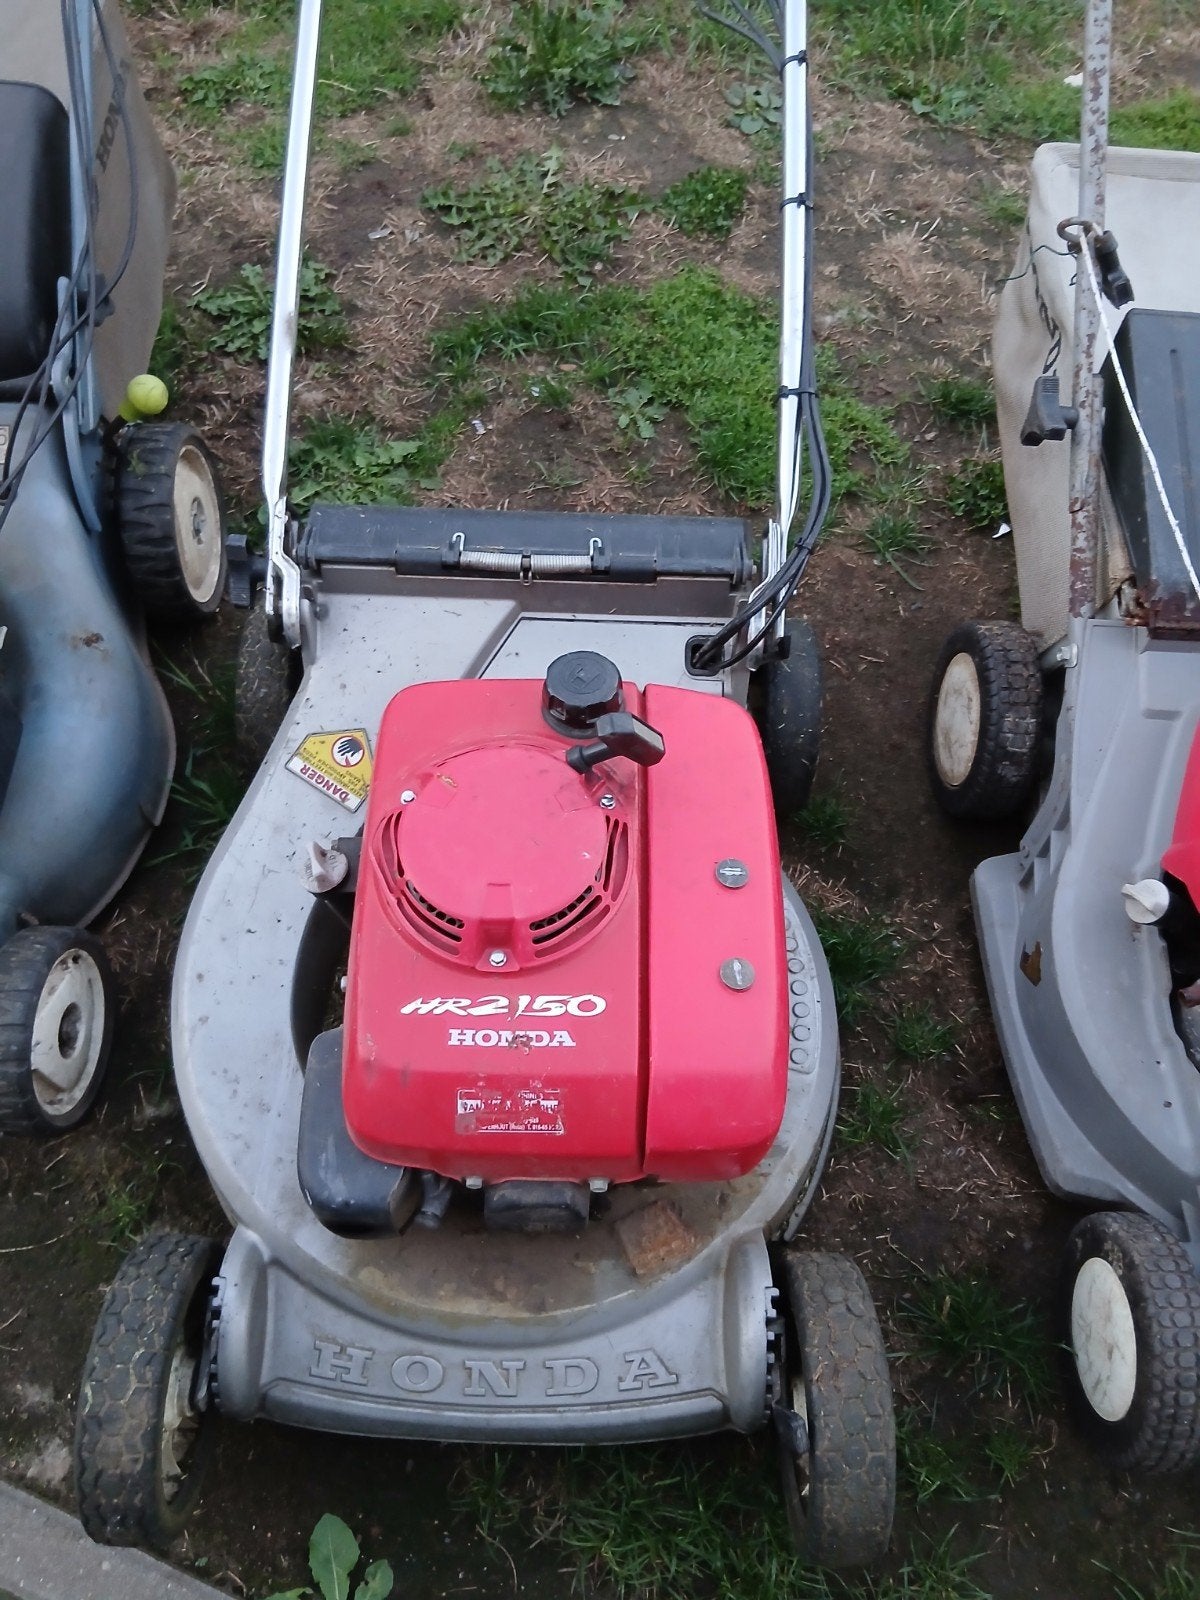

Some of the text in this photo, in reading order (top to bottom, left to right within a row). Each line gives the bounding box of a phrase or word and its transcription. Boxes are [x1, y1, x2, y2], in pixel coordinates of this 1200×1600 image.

[300, 764, 351, 803] DANGER
[448, 1028, 576, 1048] HONDA
[309, 1340, 678, 1397] HONDA
